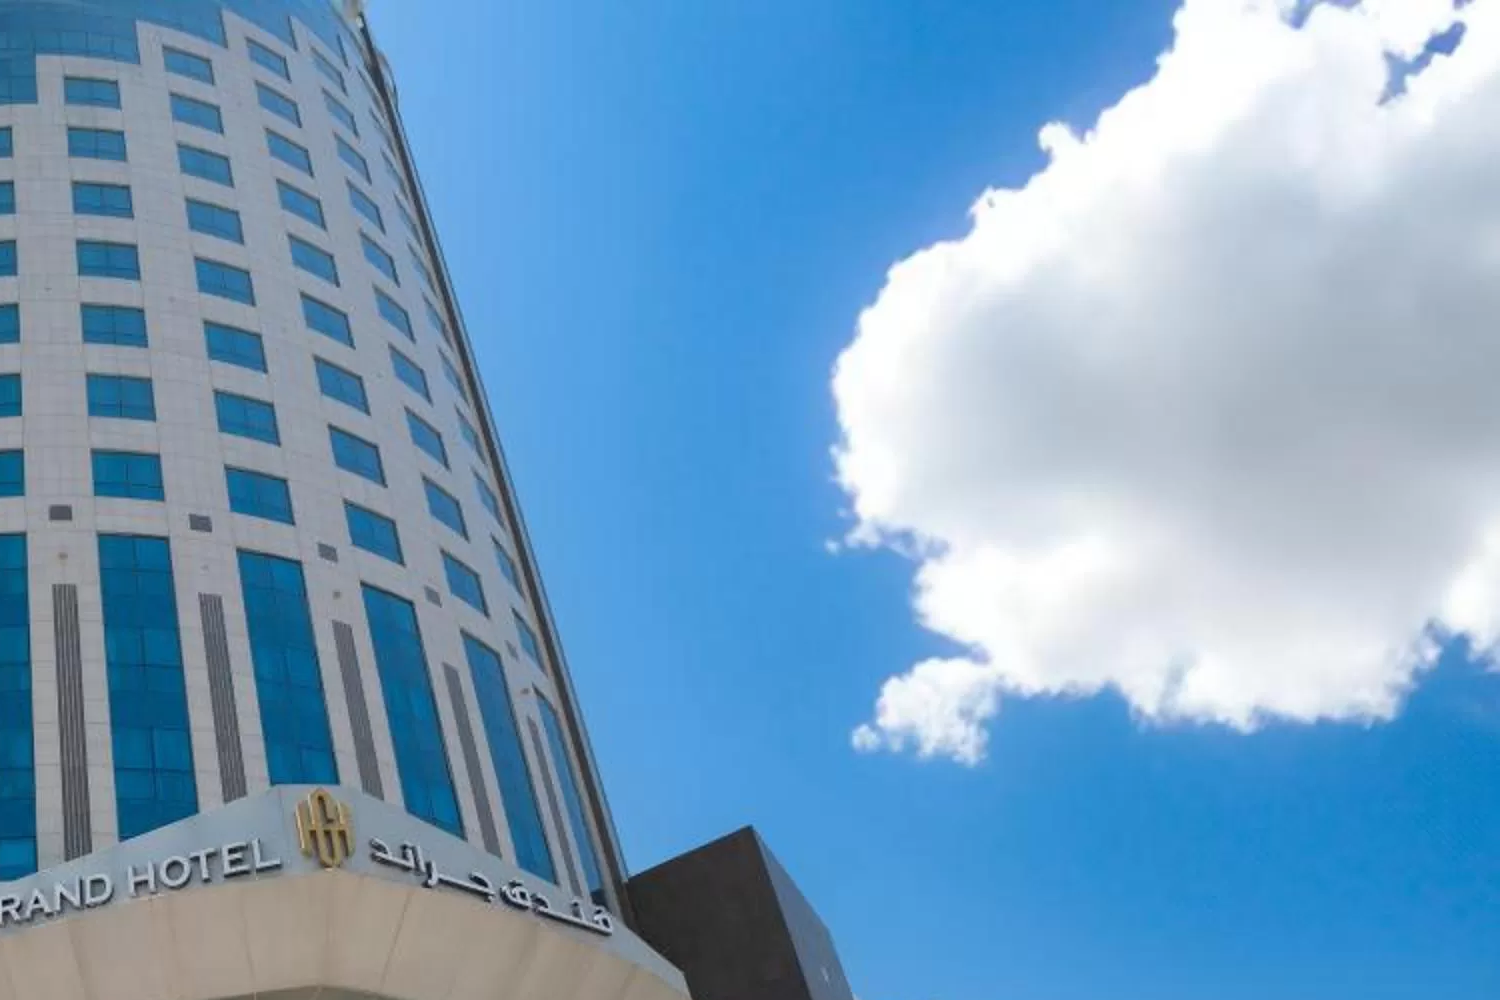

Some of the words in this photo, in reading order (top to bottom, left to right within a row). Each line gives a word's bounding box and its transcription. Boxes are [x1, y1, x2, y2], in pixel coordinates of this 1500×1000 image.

[127, 837, 283, 897] HOTEL
[368, 836, 497, 904] جراند
[501, 879, 613, 936] فندق
